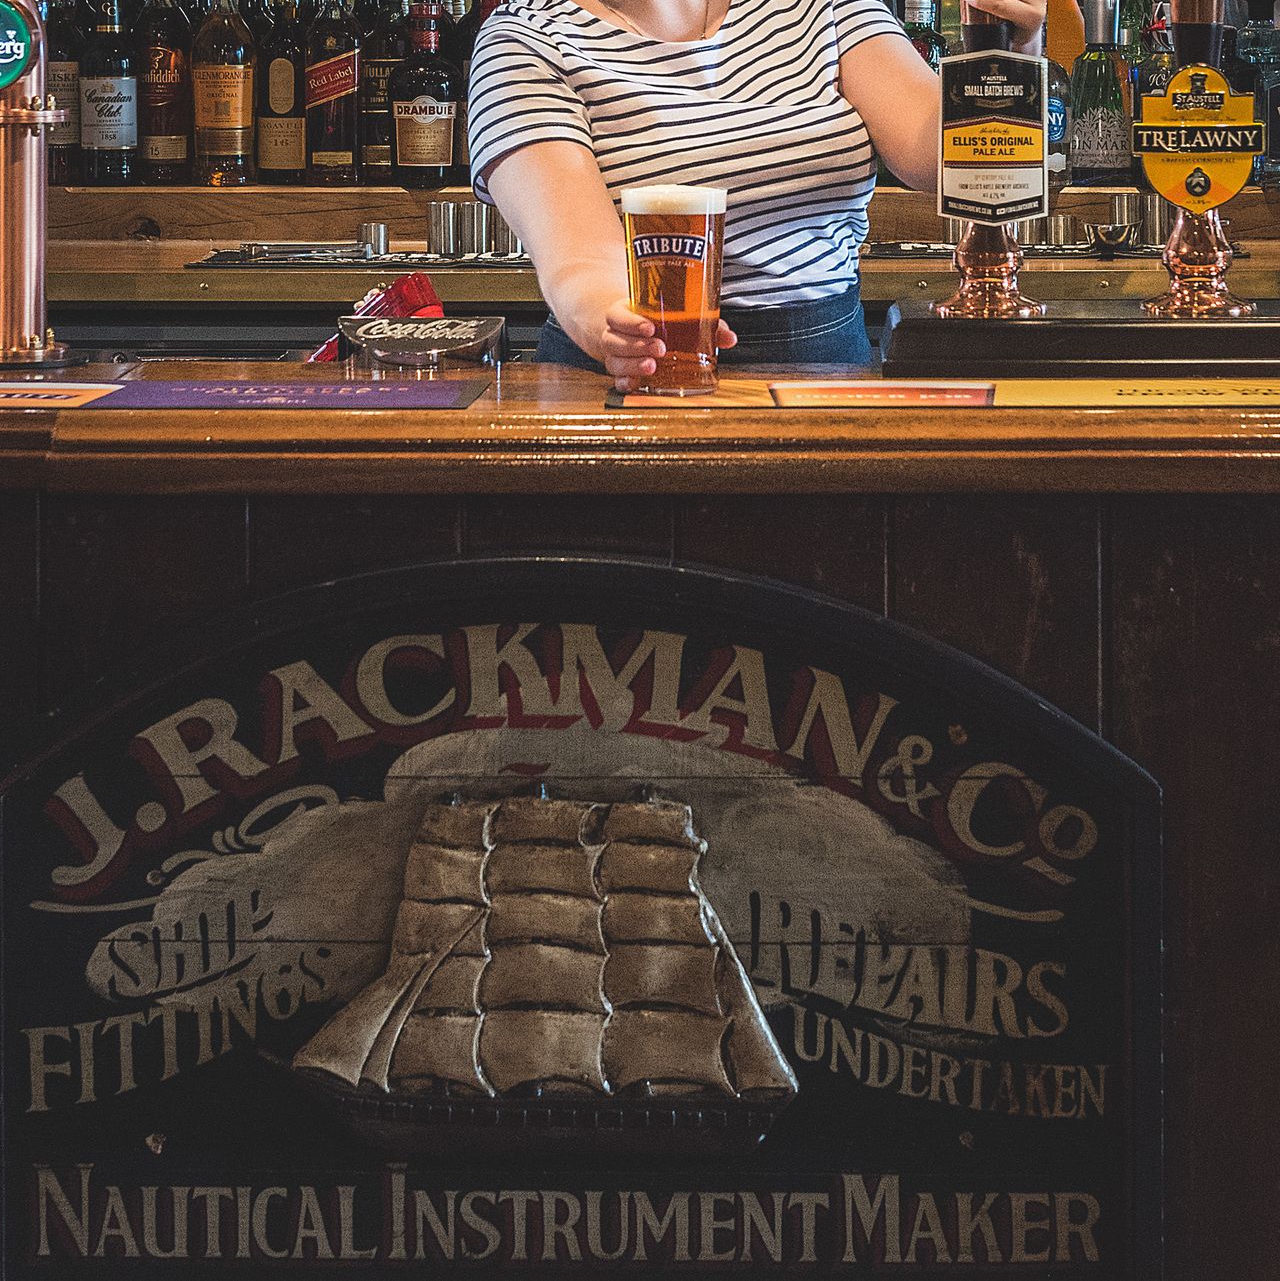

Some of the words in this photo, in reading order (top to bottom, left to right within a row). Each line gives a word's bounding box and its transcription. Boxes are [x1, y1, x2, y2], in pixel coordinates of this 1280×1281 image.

[194, 71, 251, 80] GLENMORANGIE
[309, 75, 328, 89] Red
[329, 66, 353, 82] Label
[85, 89, 132, 104] Canadian
[964, 85, 984, 96] SMALL
[984, 85, 1003, 96] BATCH
[1004, 85, 1024, 96] BREWS
[1183, 94, 1220, 104] AUSTELL
[95, 104, 121, 118] Club
[397, 106, 453, 115] DRAMBUIE
[953, 136, 988, 146] ELLIS'S
[991, 136, 1034, 146] ORIGINAL
[1138, 130, 1258, 151] TRELAWNY
[150, 147, 160, 156] 15
[973, 148, 997, 156] PALE
[998, 148, 1015, 156] ALE
[634, 236, 704, 259] TRIBUTE
[357, 318, 479, 340] Coca-Cola
[108, 889, 276, 991] SHIP
[750, 890, 1069, 1039] REPAIRS
[21, 946, 333, 1113] FITTINGS
[789, 1002, 1108, 1119] UNDERTAKEN
[33, 1163, 377, 1261] NAUTICAL
[388, 1163, 829, 1263] INSTRUMENT
[841, 1174, 1102, 1264] MAKER
